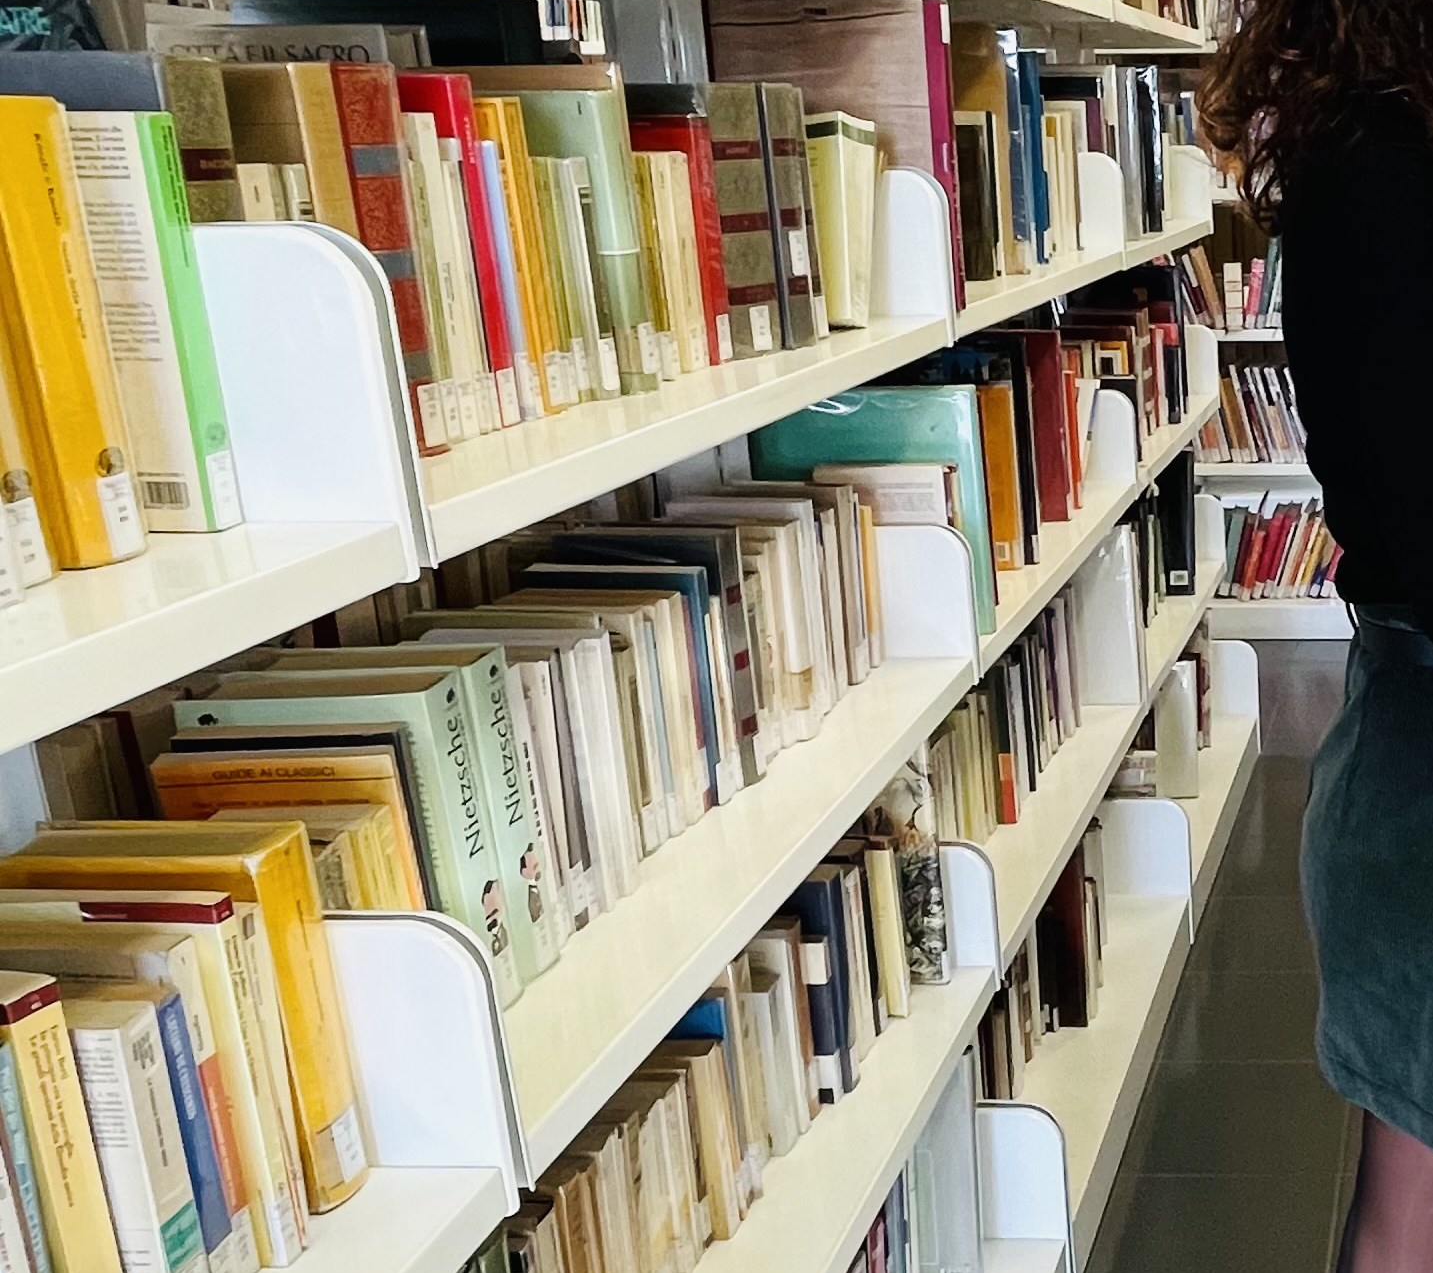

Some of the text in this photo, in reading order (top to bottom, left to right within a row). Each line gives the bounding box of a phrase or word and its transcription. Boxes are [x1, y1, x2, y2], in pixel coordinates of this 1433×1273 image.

[286, 44, 371, 63] SACRO
[212, 766, 336, 781] GUIDE AI CLASSICI
[447, 715, 485, 860] Nietzsche
[490, 689, 524, 827] Nietzsche
